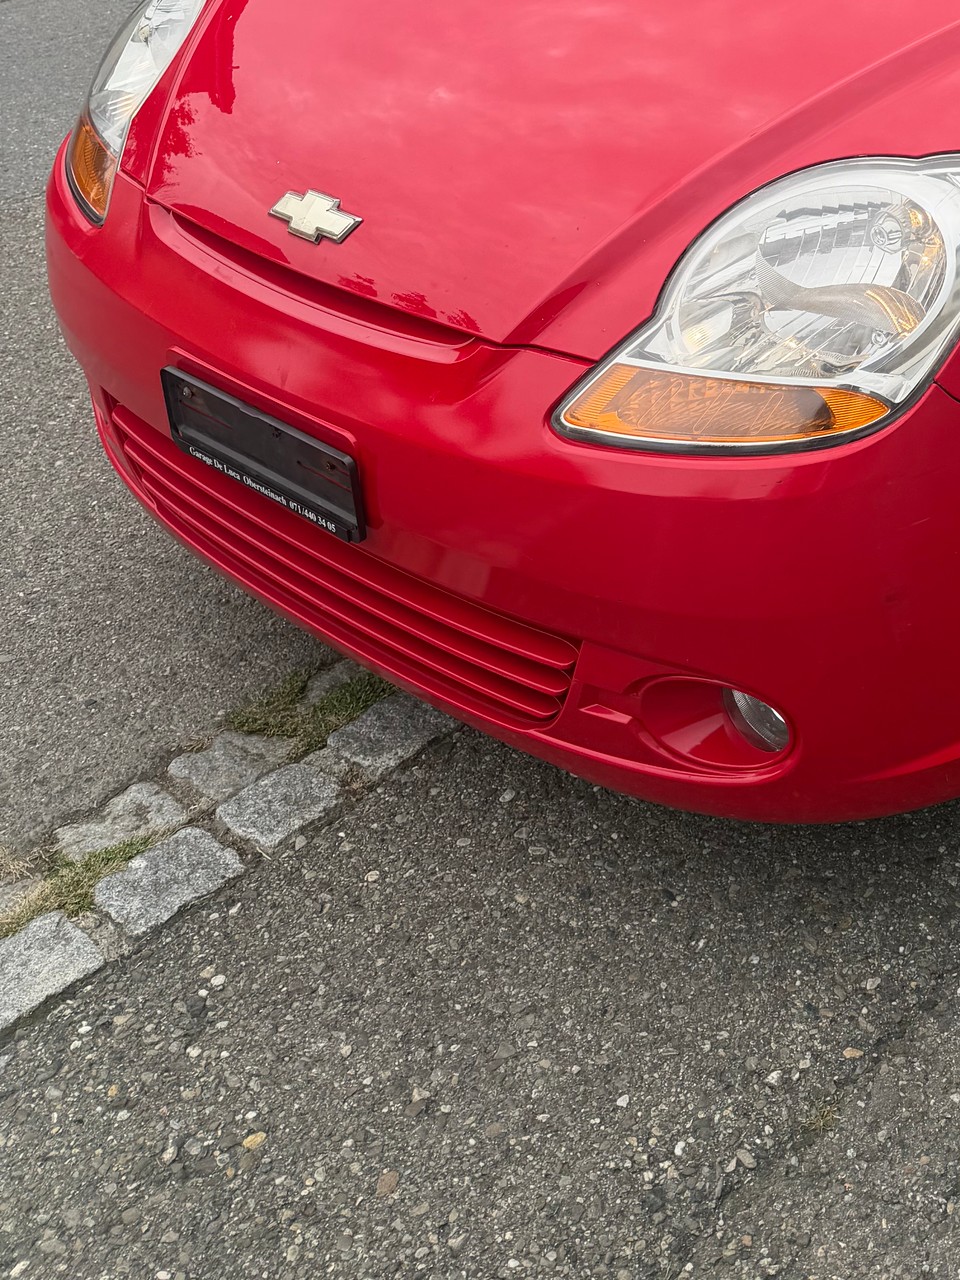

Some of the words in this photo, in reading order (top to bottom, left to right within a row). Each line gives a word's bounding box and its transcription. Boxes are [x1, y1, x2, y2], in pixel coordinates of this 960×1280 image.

[189, 446, 213, 466] Garage
[213, 459, 223, 471] De
[223, 464, 241, 481] Luca
[243, 475, 287, 506] Obersteinach
[317, 516, 326, 528] 34
